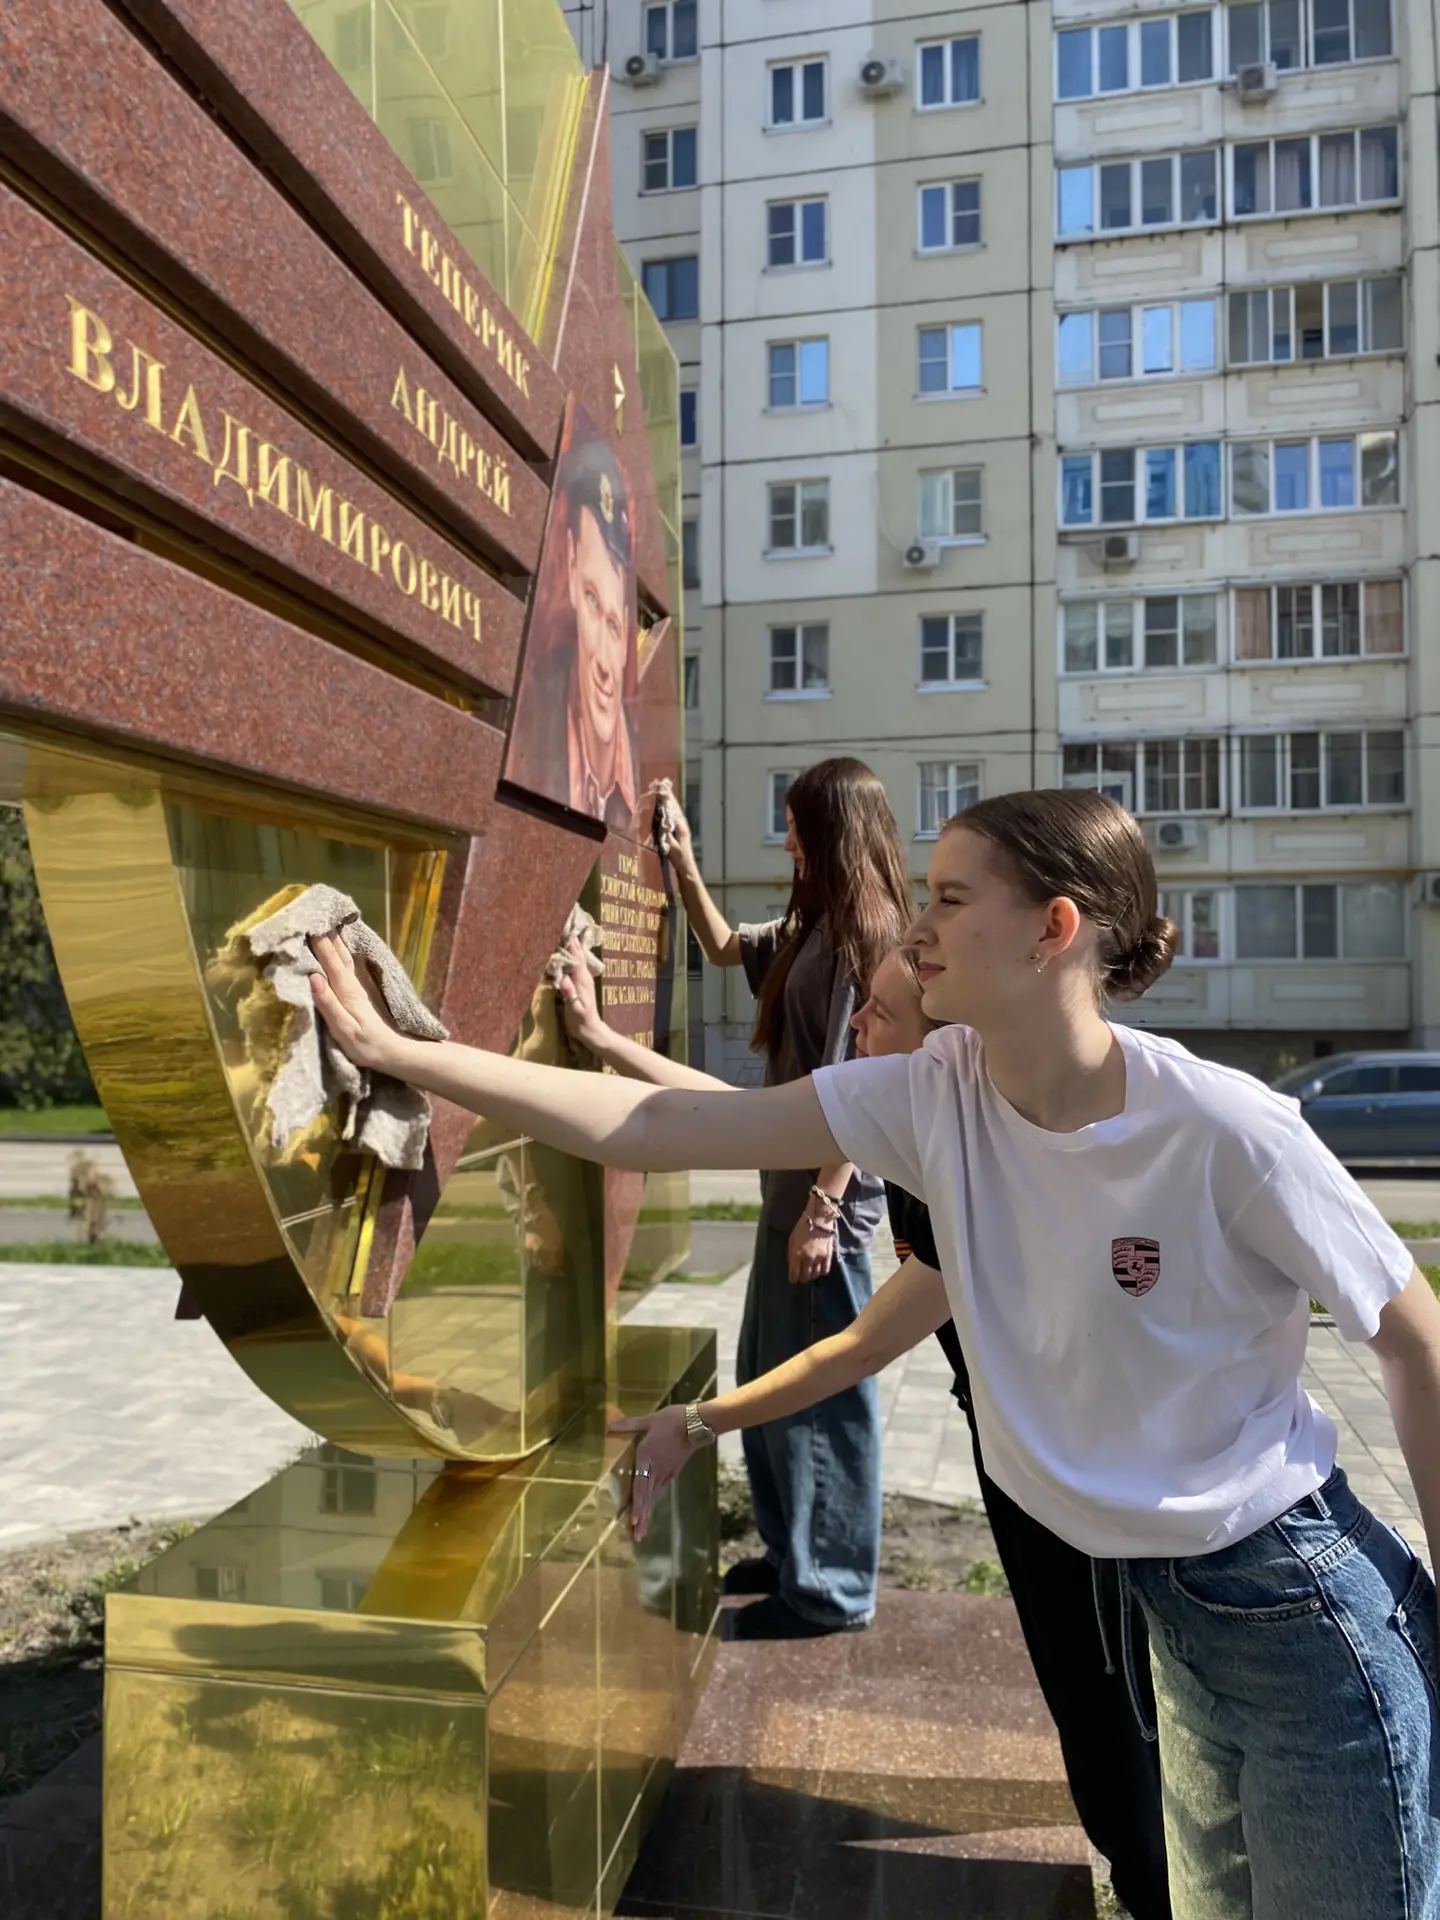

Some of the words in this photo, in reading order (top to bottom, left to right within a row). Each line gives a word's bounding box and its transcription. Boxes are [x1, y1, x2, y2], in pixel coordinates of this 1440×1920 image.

[396, 190, 531, 400] ТЕПЕРИК
[65, 293, 483, 642] ВЛАДИМИРОВИЧ
[390, 365, 512, 517] АНДРЕЙ
